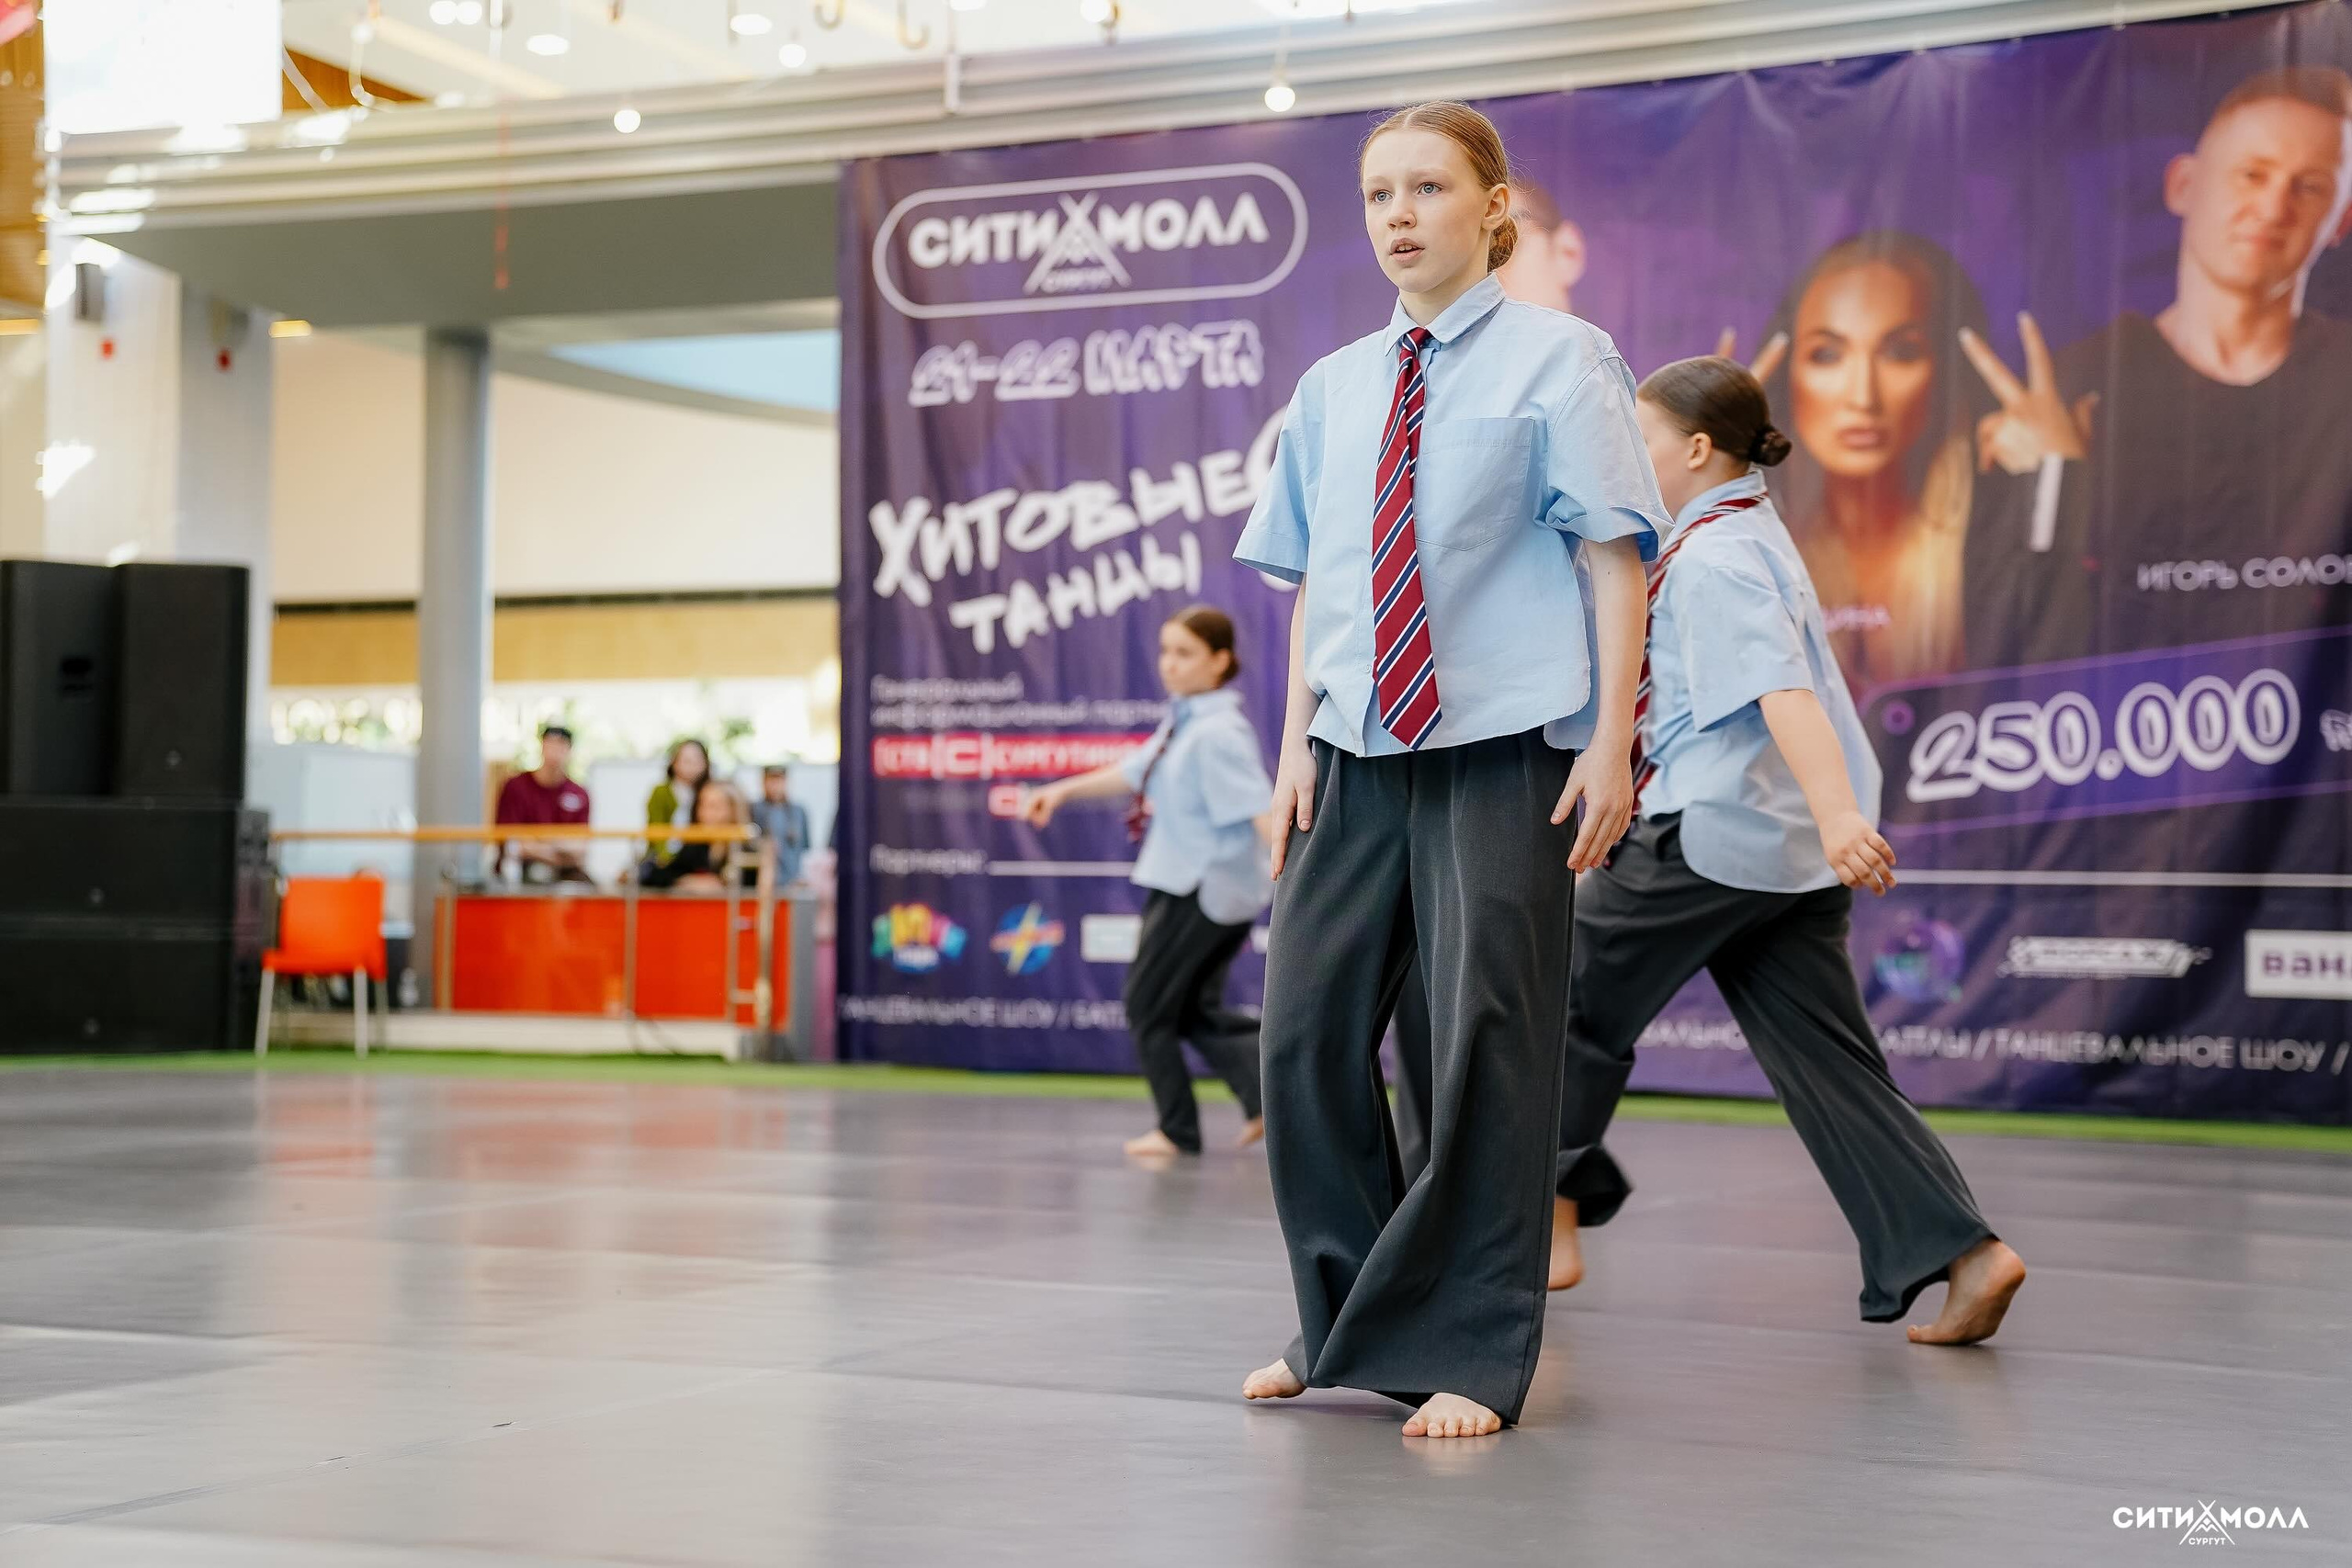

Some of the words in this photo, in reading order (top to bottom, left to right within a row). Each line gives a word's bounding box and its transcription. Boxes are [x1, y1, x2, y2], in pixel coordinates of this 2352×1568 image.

[908, 213, 1055, 268] СИТИ
[1098, 192, 1270, 255] МОЛЛ
[868, 448, 1255, 607] ХИТОВЫЕ
[948, 531, 1204, 655] ТАНЦЫ
[1906, 668, 2301, 802] 250.000
